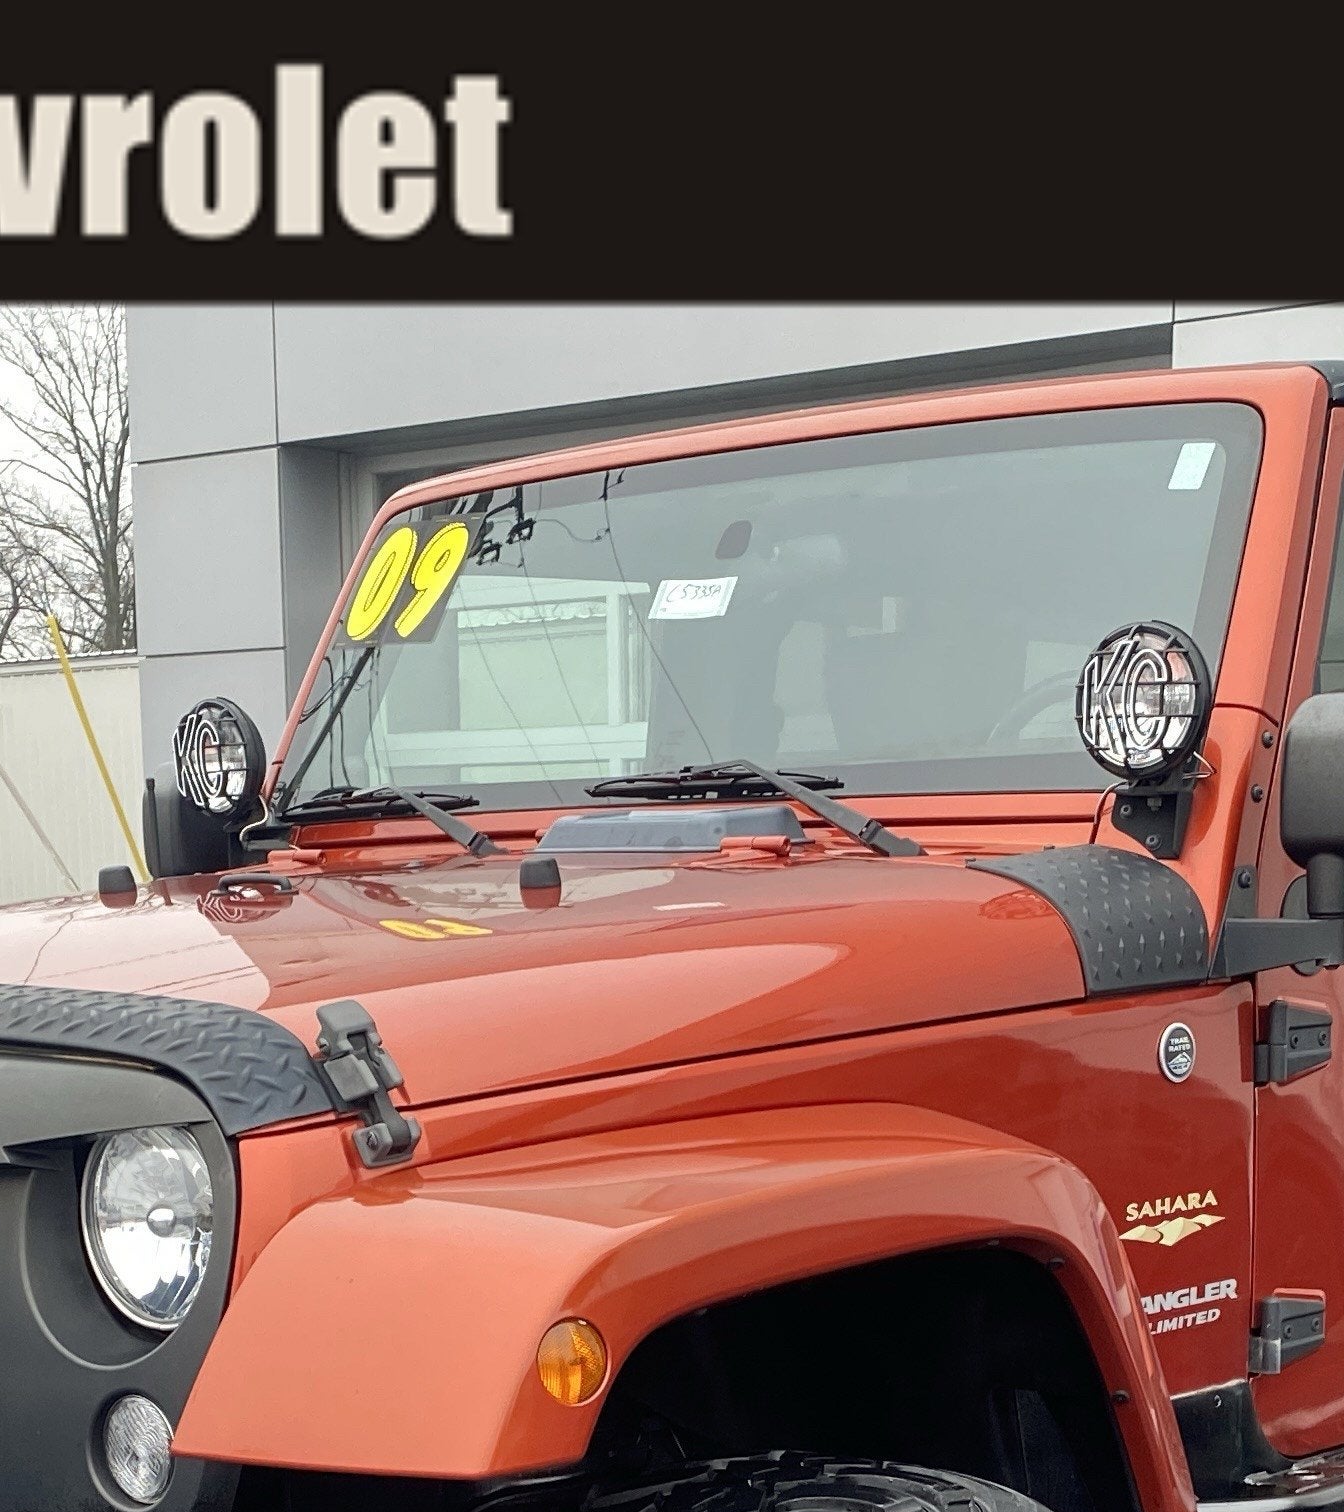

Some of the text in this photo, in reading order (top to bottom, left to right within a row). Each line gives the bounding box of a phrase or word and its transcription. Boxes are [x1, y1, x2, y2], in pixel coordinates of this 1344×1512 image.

[346, 521, 471, 641] 09
[1082, 639, 1170, 761] KC
[172, 713, 224, 807] KC
[1125, 1189, 1219, 1222] SAHARA
[1139, 1278, 1239, 1316] ANGLER
[1147, 1308, 1222, 1336] LIMITED
